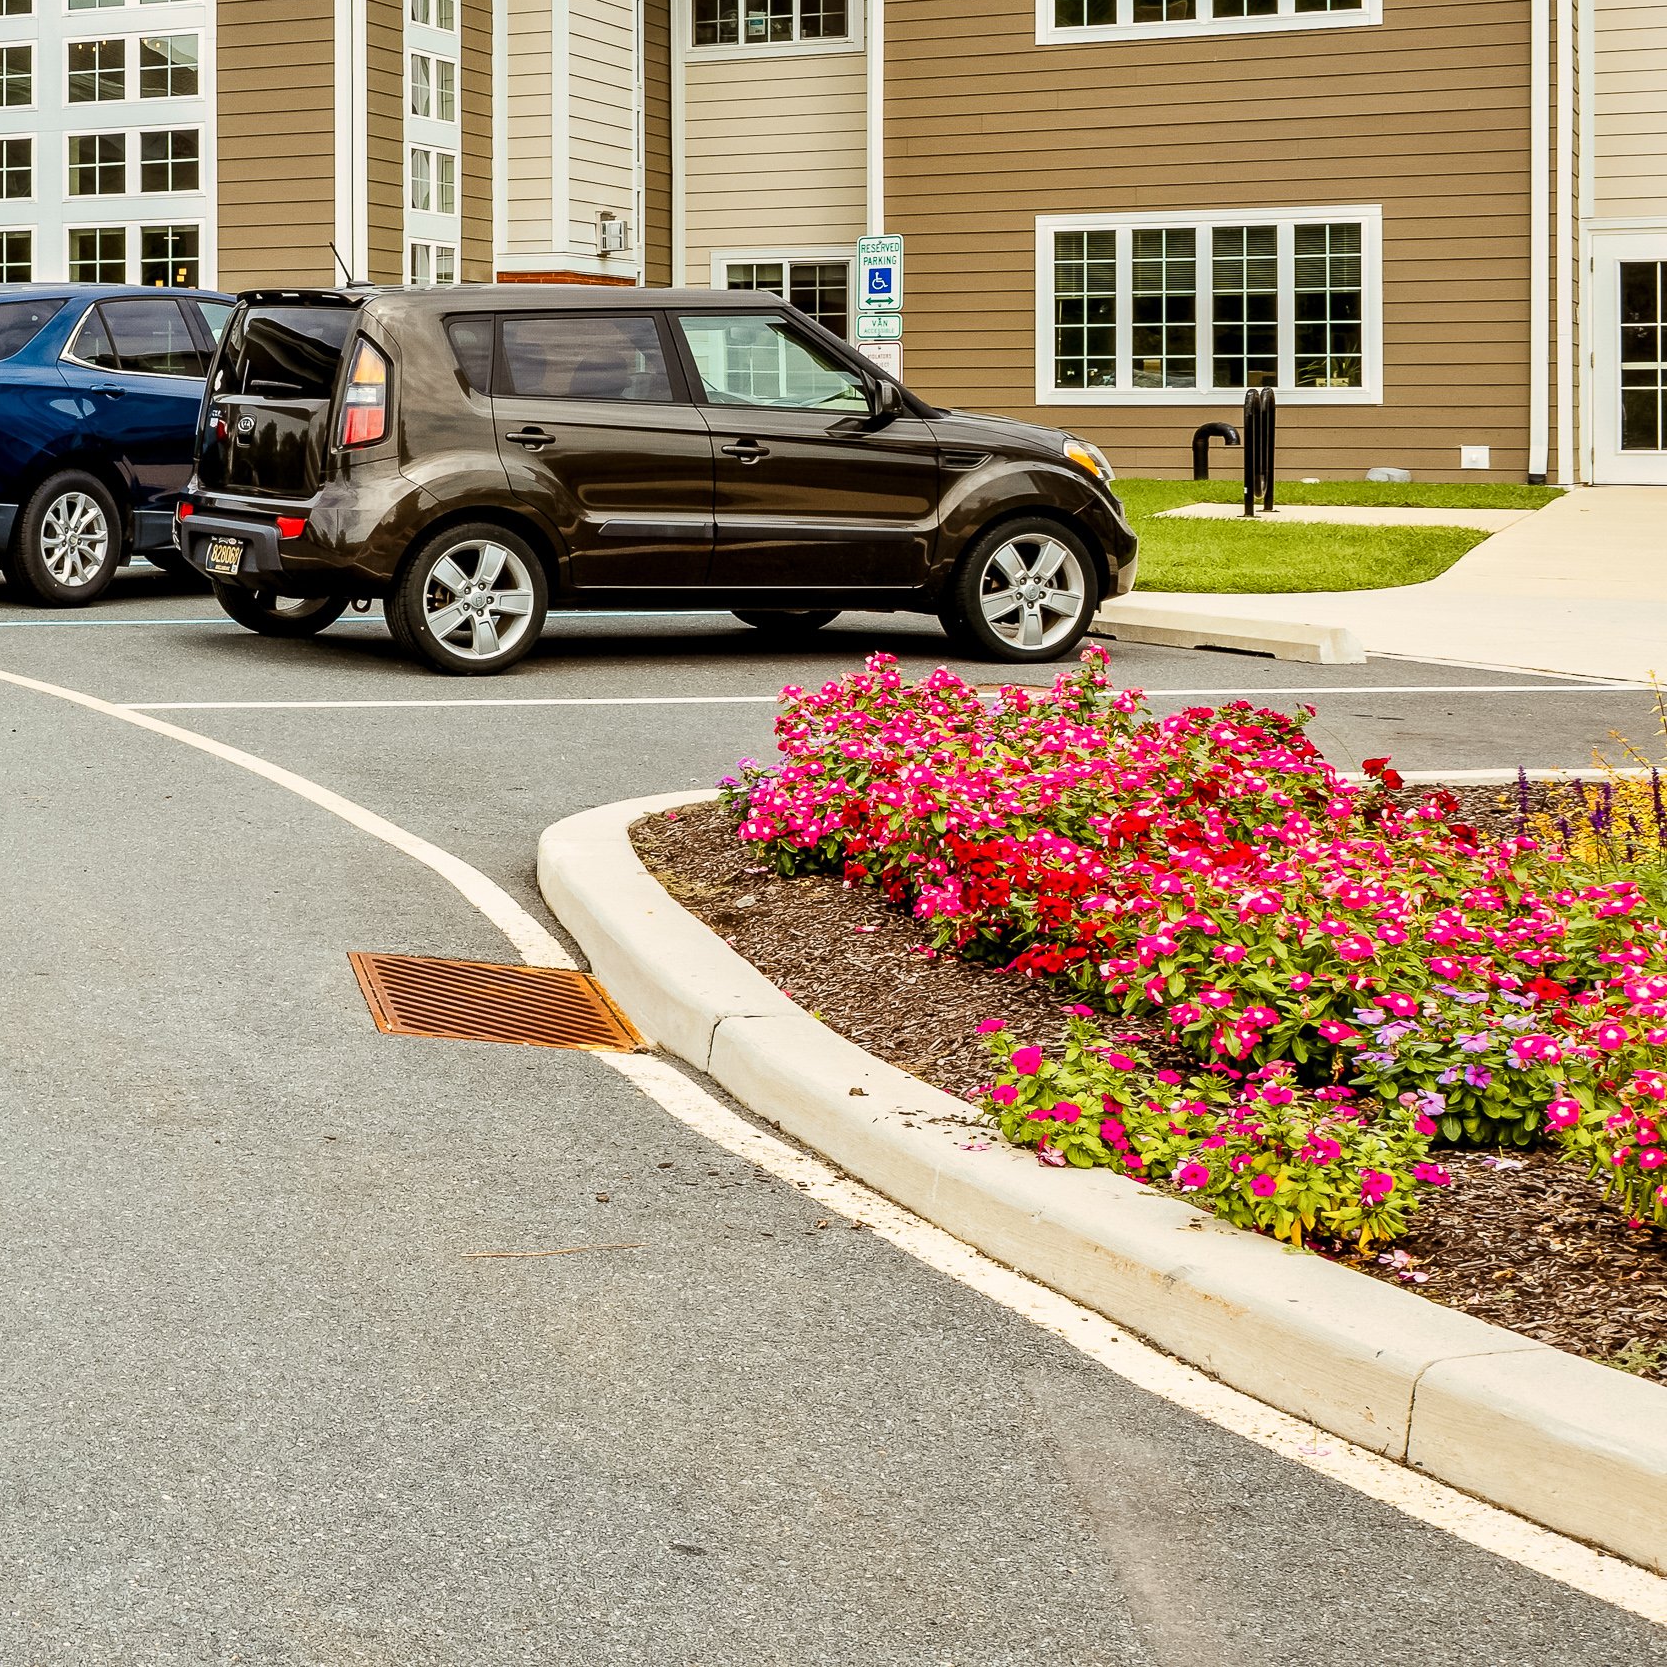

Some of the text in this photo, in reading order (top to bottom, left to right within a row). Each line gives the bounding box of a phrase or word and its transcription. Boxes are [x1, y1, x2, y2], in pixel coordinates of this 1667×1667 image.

[861, 242, 899, 253] RESERVED
[863, 255, 897, 265] PARKING
[871, 319, 889, 327] VAN
